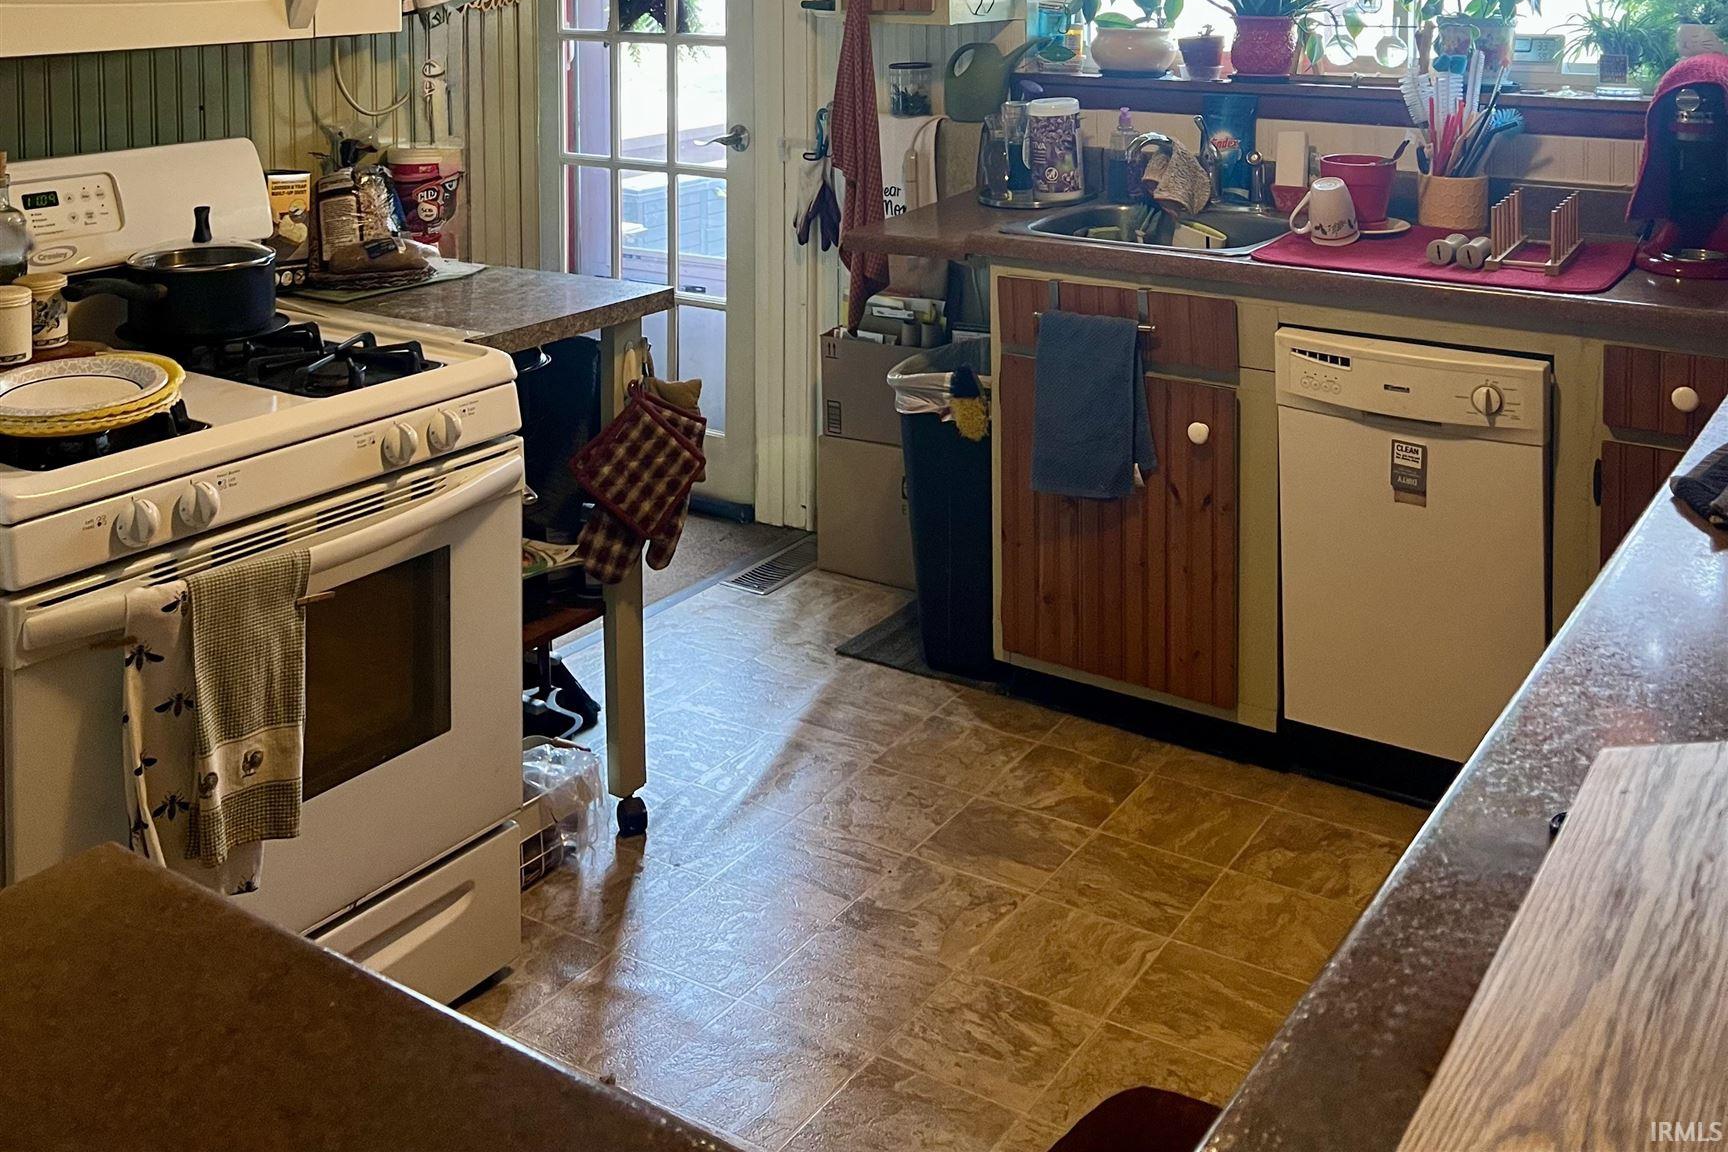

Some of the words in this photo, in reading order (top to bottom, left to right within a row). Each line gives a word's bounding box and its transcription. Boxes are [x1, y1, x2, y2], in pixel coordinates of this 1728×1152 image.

[1211, 137, 1238, 150] index
[884, 185, 902, 197] ear
[1396, 443, 1419, 456] CLEAN
